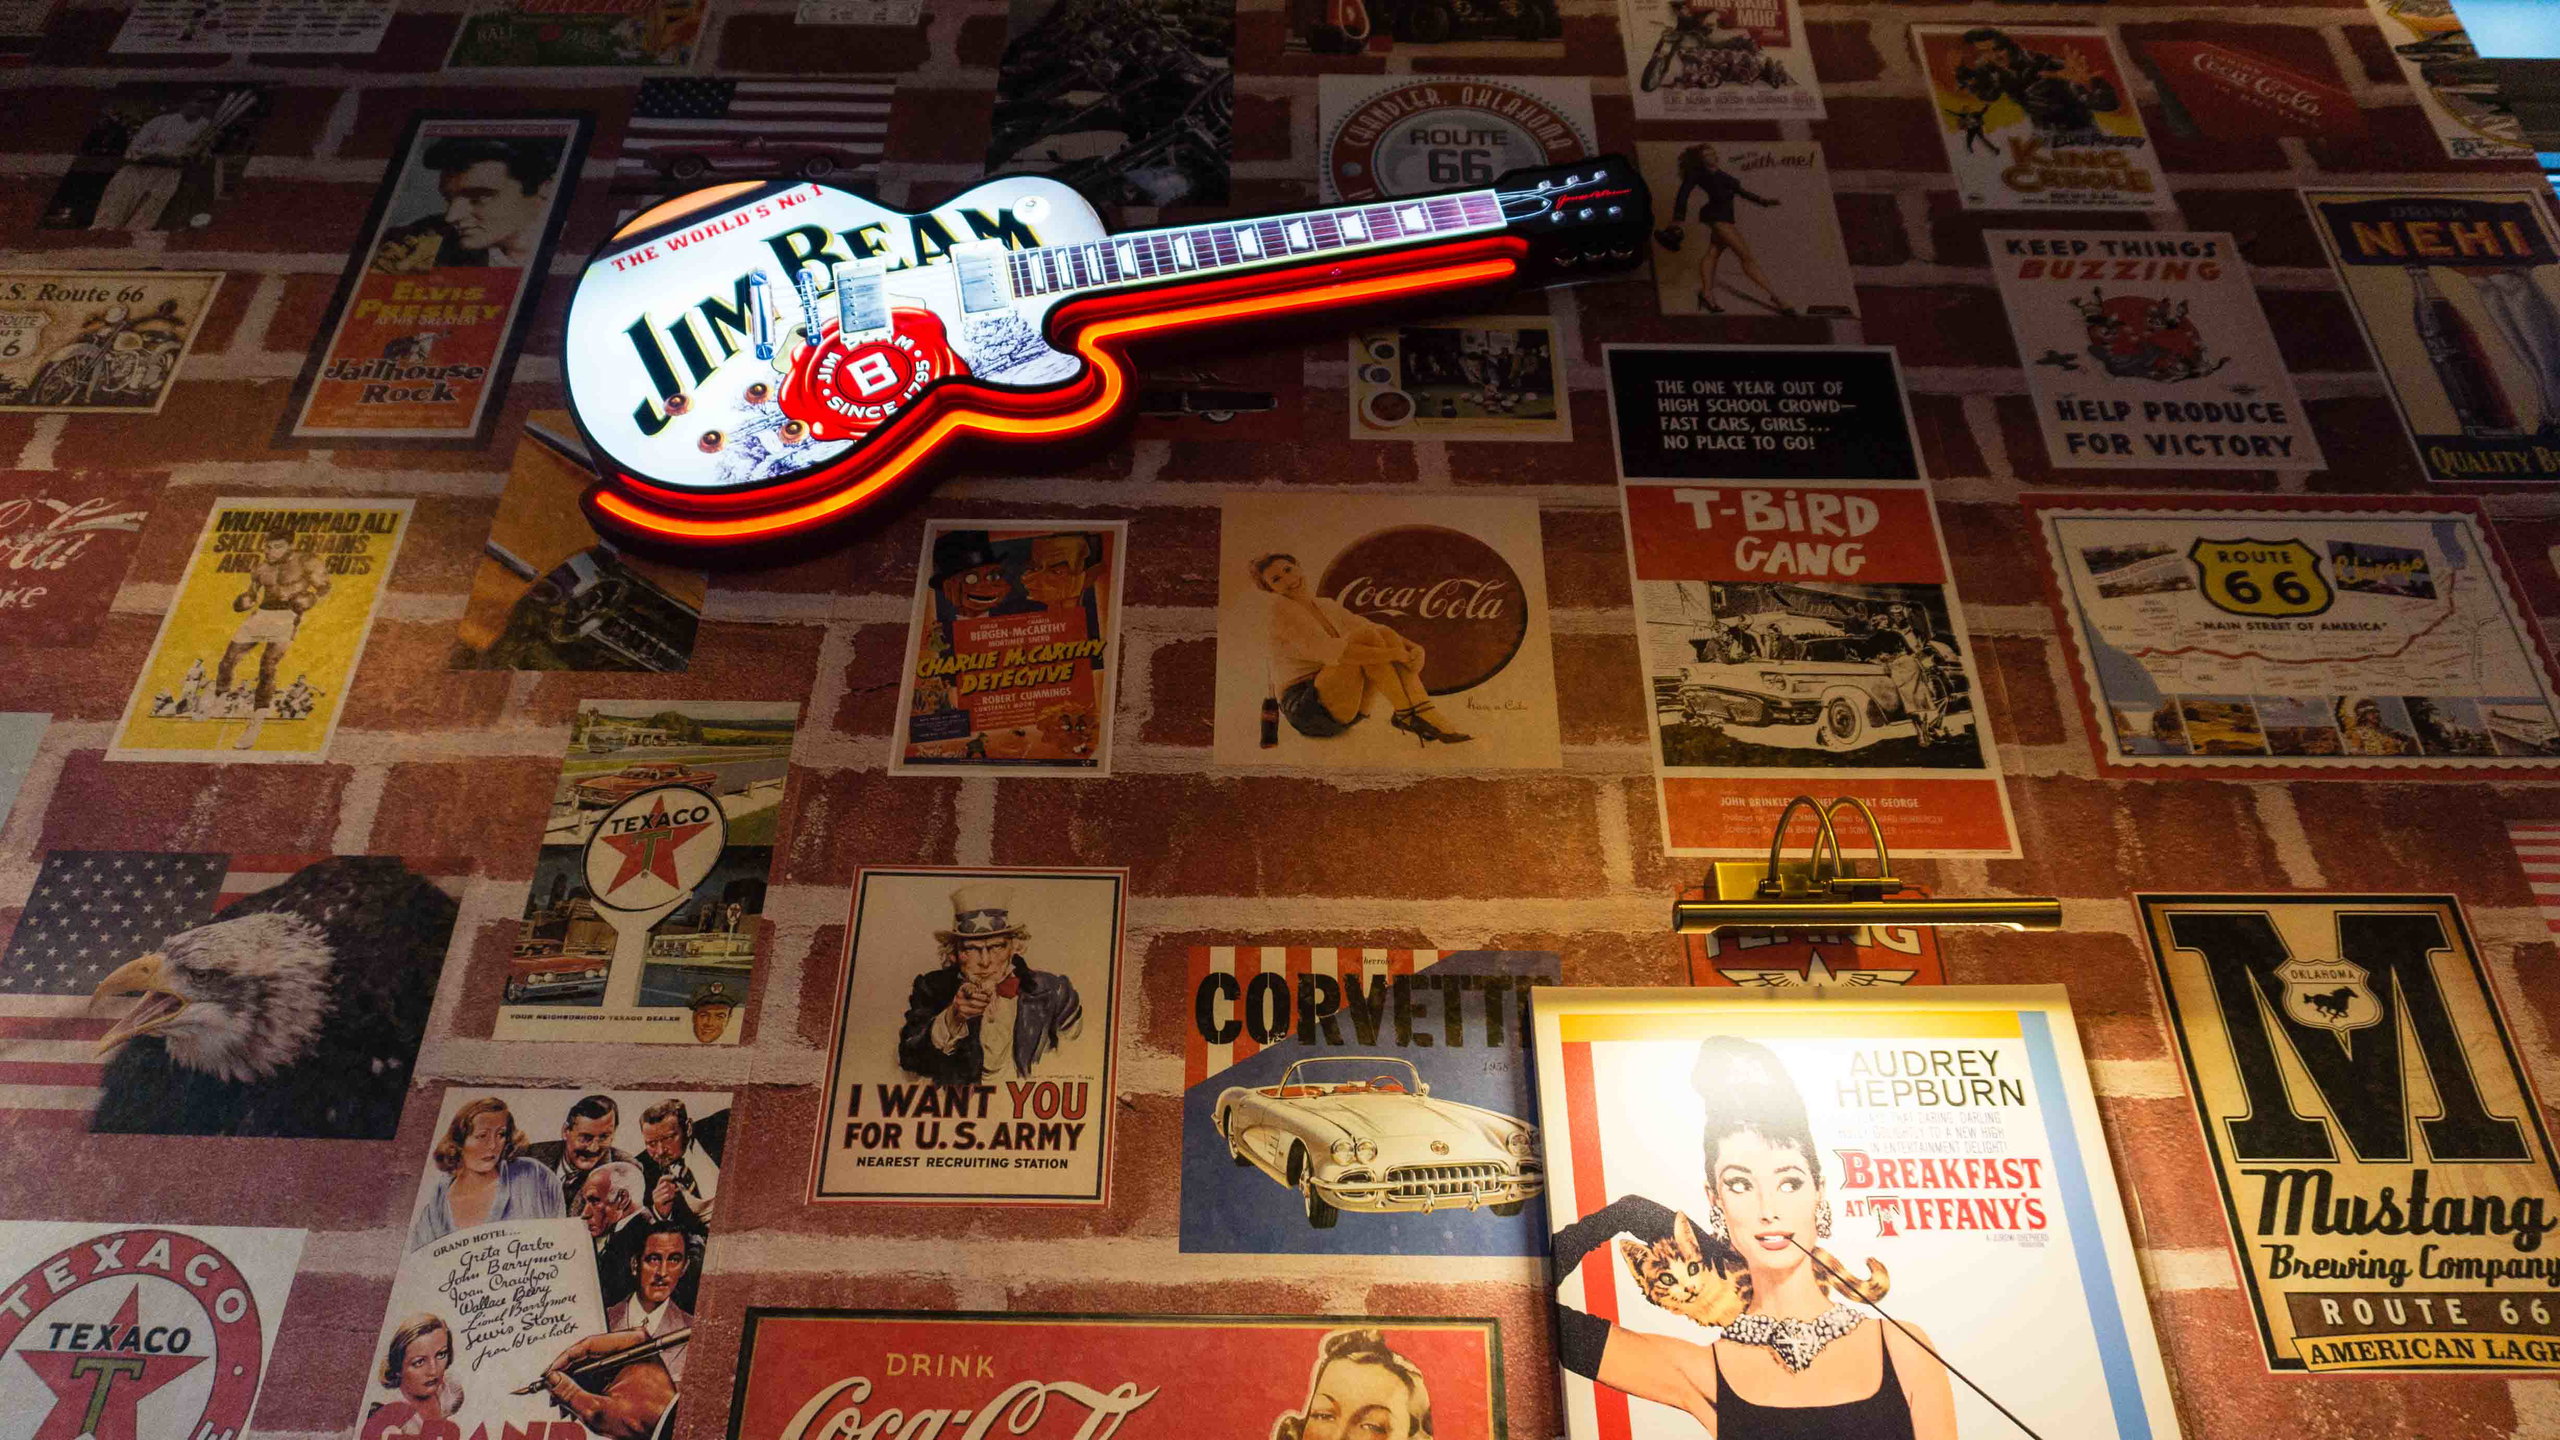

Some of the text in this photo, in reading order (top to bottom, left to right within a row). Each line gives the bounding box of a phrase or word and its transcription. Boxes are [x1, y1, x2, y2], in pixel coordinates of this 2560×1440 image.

[1410, 128, 1509, 147] ROUTE
[1428, 149, 1493, 184] 66
[611, 246, 660, 272] THE
[664, 204, 771, 252] WORLD'S
[2006, 240, 2217, 258] KEEP THINGS
[2352, 220, 2534, 257] NEHI
[760, 207, 1044, 302] BEAM
[2018, 260, 2222, 281] BUZZING
[37, 283, 147, 303] Route 66
[391, 280, 488, 301] ELVIS
[354, 299, 503, 320] PRESLEY
[621, 270, 783, 437] JIM
[323, 358, 485, 382] Jailhouse
[816, 351, 842, 384] JIM
[846, 352, 899, 397] B
[359, 382, 459, 404] Rock
[1656, 379, 1844, 396] THE ONE YEAR OUT OF
[826, 395, 899, 419] SINCE
[1658, 398, 1700, 413] HIGH
[1706, 398, 1772, 413] SCHOOL
[2056, 400, 2287, 424] HELP PRODUCE
[1660, 416, 1699, 432] FAST
[1707, 416, 1756, 434] CARS,
[1664, 435, 1816, 451] NO PLACE TO GO!
[2066, 433, 2293, 457] FOR VICTORY
[215, 511, 399, 534] MUHAMMAD ALI
[1734, 536, 1866, 576] GANG
[2217, 551, 2292, 564] ROUTE
[1336, 575, 1507, 620] Coca-Cola
[2225, 570, 2310, 604] 66
[2247, 622, 2290, 631] STREET
[2297, 622, 2314, 631] OF
[916, 650, 1000, 680] CHARLIE
[961, 661, 1076, 696] DETECTIVE
[982, 687, 1072, 705] ROBERT CUMMINGS
[1721, 797, 1746, 807] JOHN
[1881, 798, 1920, 808] GEORGE
[611, 805, 709, 835] TEXACO
[2289, 967, 2358, 981] OKLAHOMA
[2164, 909, 2535, 1164] M
[1849, 1049, 2000, 1077] AUDREY
[847, 1081, 1088, 1120] I WANT YOU
[1836, 1078, 2027, 1107] HEPBURN
[843, 1122, 903, 1149] FOR
[988, 1122, 1086, 1151] ARMY
[1955, 1127, 1977, 1138] NEW
[1981, 1127, 2006, 1139] HIGH
[1884, 1141, 1960, 1154] ENTERTAINMENT
[856, 1156, 1069, 1169] NEAREST RECRUITING STATION
[1834, 1149, 2043, 1190] BREAKFAST
[1845, 1192, 2047, 1237] AT TIFFANY'S
[2241, 1168, 2558, 1252] Mustang
[433, 1238, 470, 1258] GRAND
[460, 1247, 501, 1271] Greta
[438, 1249, 577, 1293] John Barrymore
[2260, 1244, 2560, 1288] Brewing Company
[3, 1237, 248, 1325] TEXACO
[449, 1265, 559, 1308] Joan Crawford
[459, 1284, 552, 1316] Wallace Beery
[2319, 1297, 2468, 1326] ROUTE
[460, 1308, 508, 1334] Lionel
[465, 1312, 573, 1350] Lewis Stone
[49, 1322, 192, 1354] TEXACO
[2310, 1338, 2475, 1365] AMERICAN
[471, 1345, 511, 1372] Jean
[886, 1352, 995, 1379] DRINK
